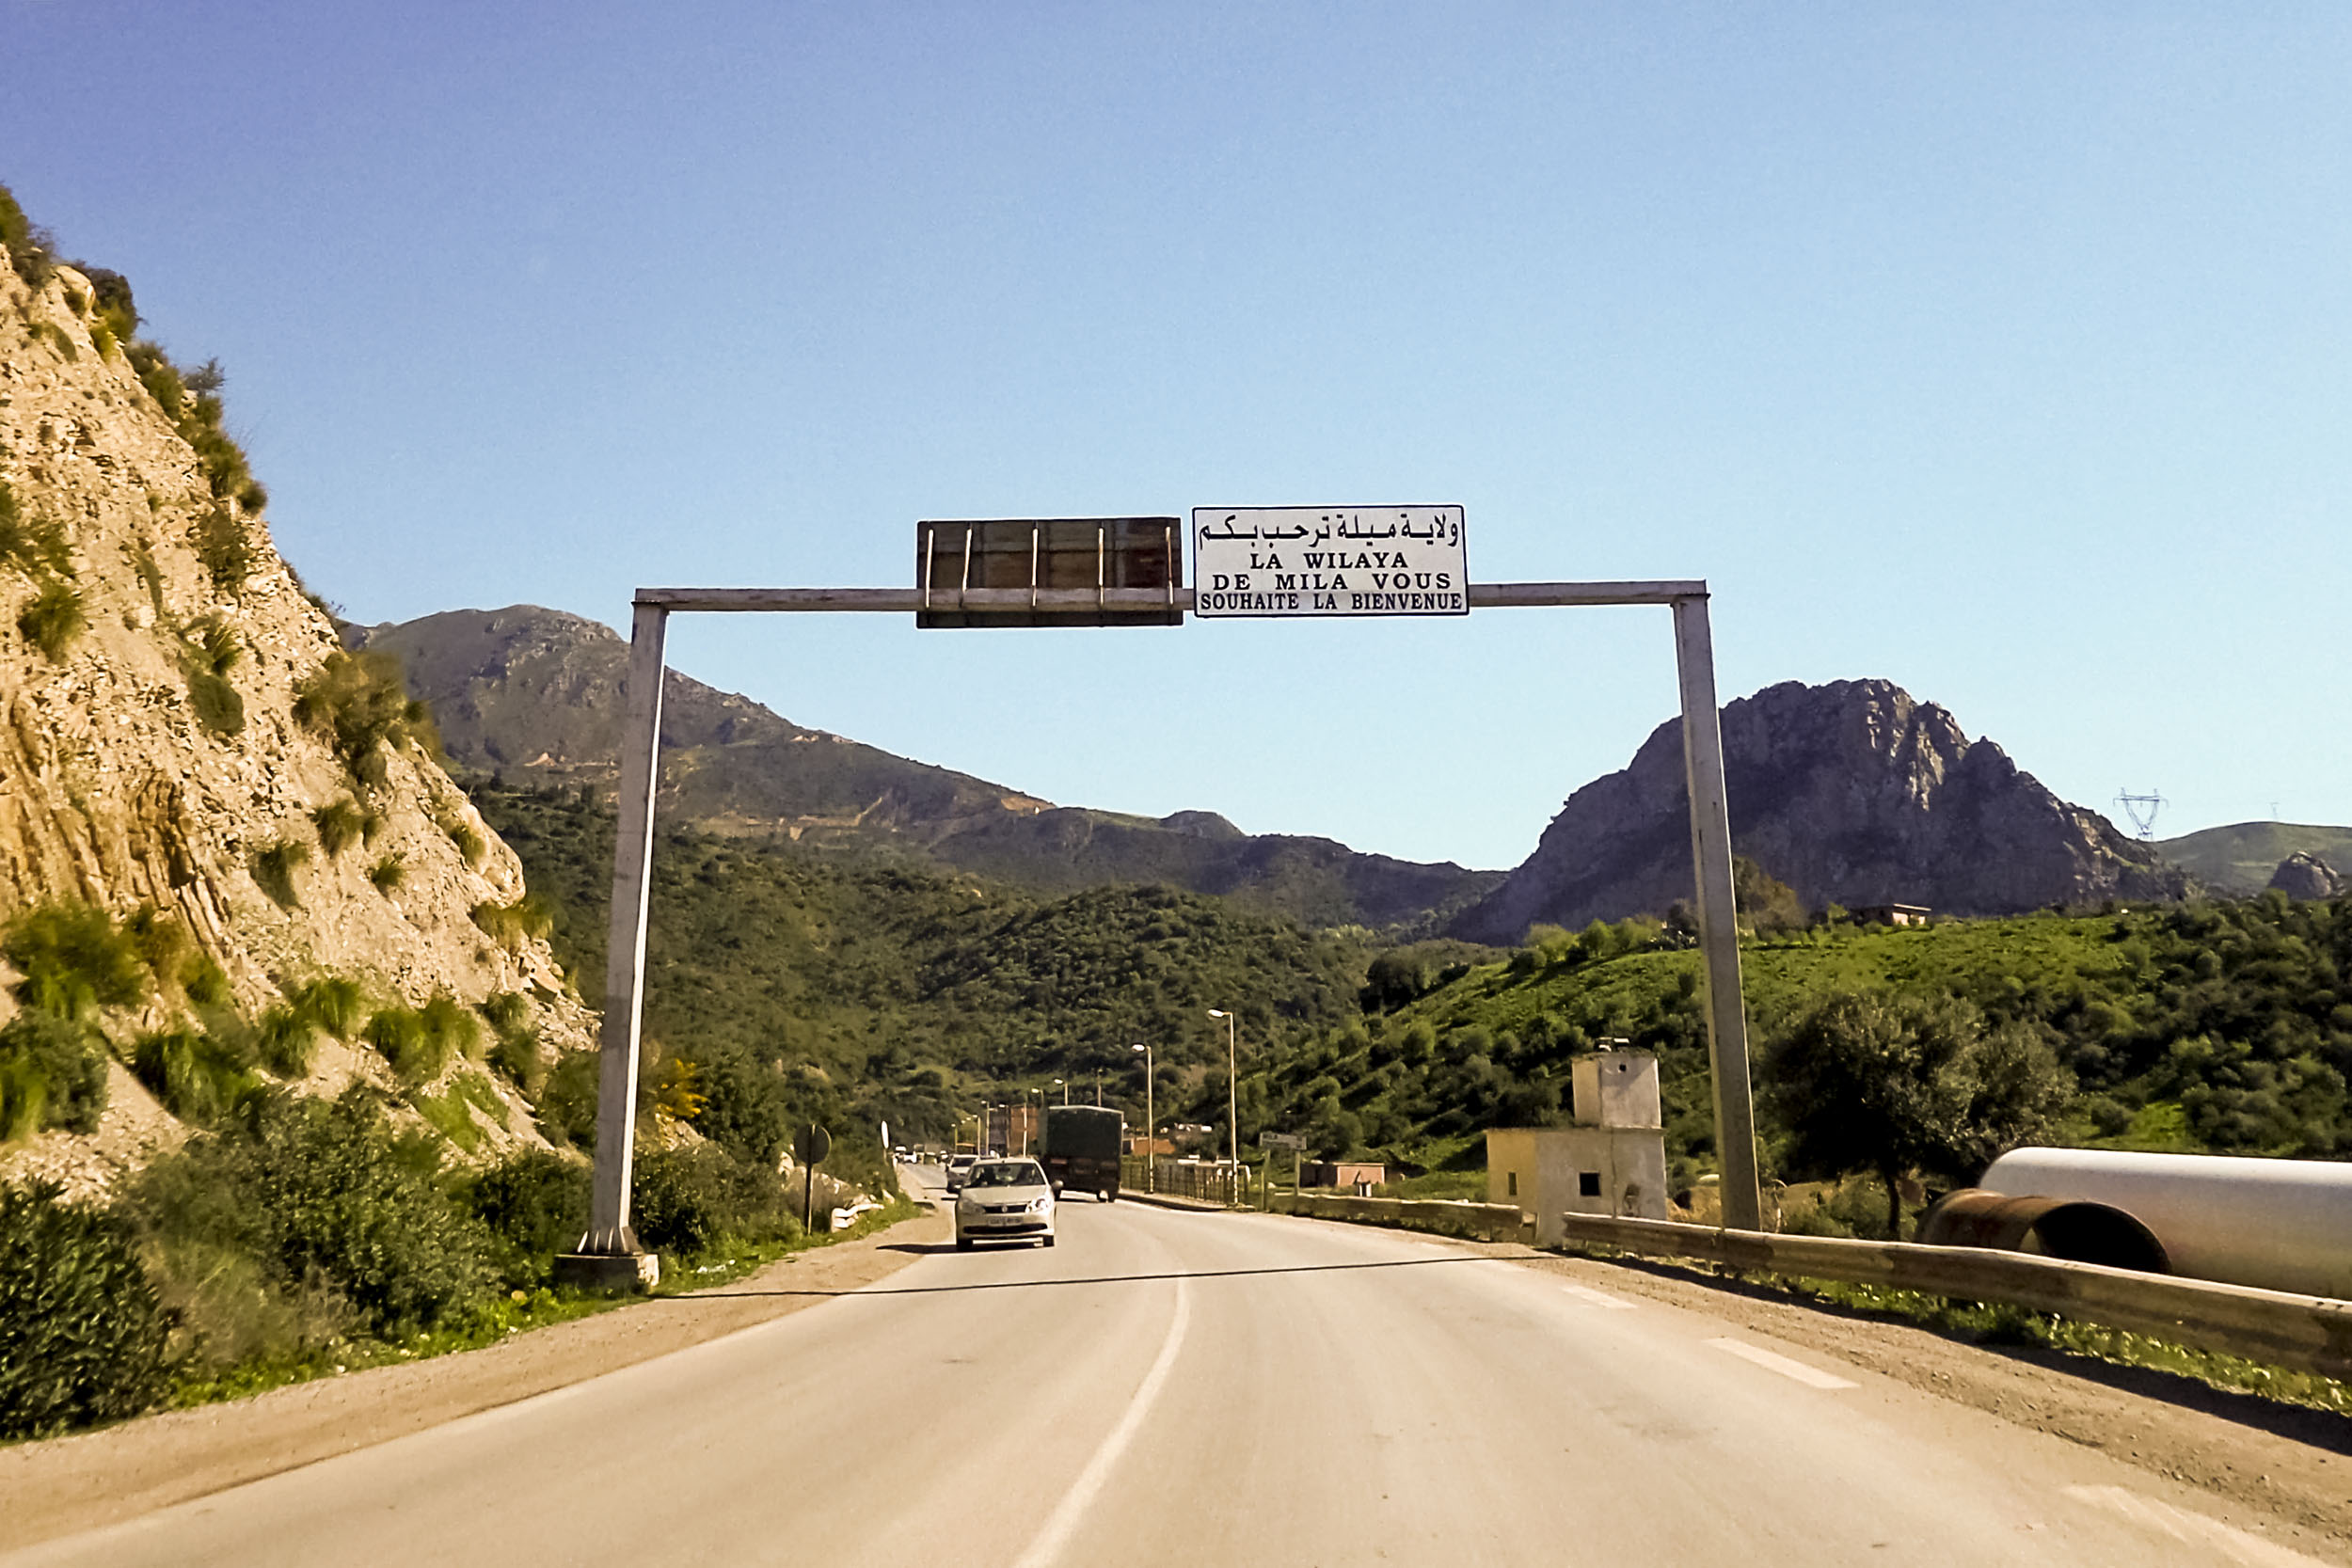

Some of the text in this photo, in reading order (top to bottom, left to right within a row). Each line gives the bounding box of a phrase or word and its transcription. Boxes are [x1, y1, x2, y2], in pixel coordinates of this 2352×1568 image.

[1199, 513, 1458, 550] ولاية ميلة ترحب بكم
[1249, 552, 1408, 570] LA WILAYA
[1212, 572, 1451, 591] DE MILA VOUS
[1200, 593, 1463, 610] SOUHAITE LA BIENVENUE
